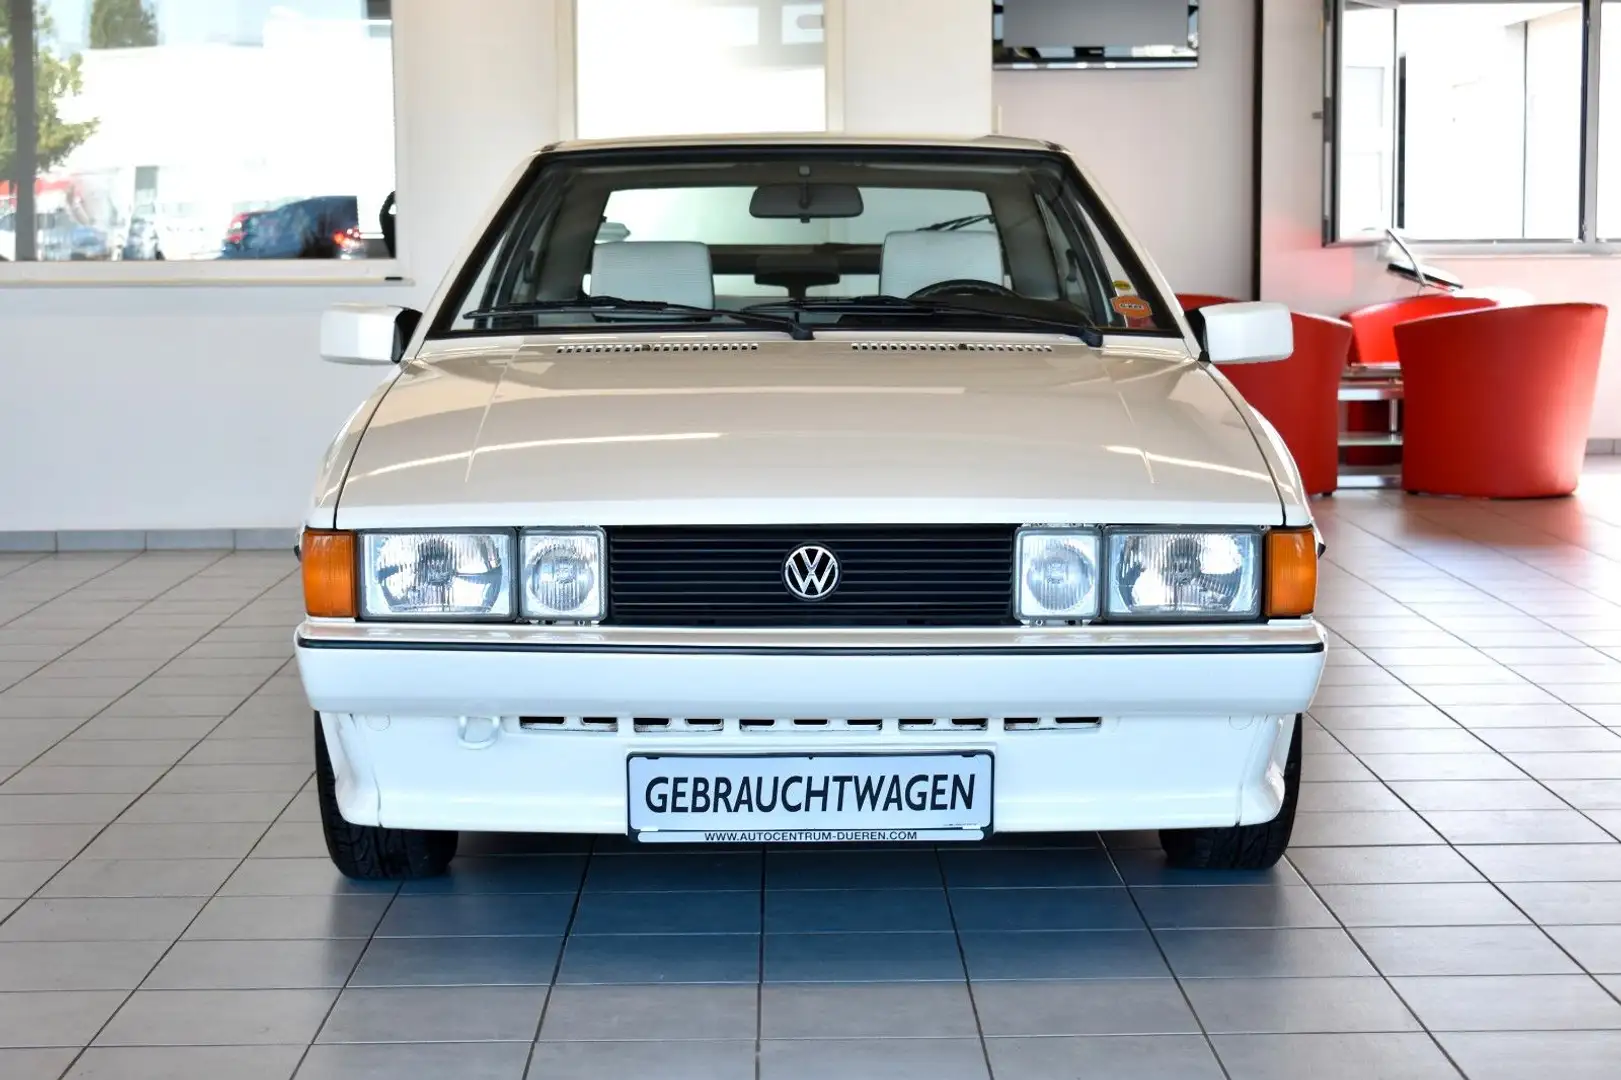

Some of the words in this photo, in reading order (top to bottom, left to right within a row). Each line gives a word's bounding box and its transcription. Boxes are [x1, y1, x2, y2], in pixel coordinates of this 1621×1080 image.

[785, 546, 838, 598] VW
[645, 774, 976, 813] GEBRAUCHTWAGEN
[704, 831, 918, 842] WWW.AUTOCENTRUM-DUEREN.COM
